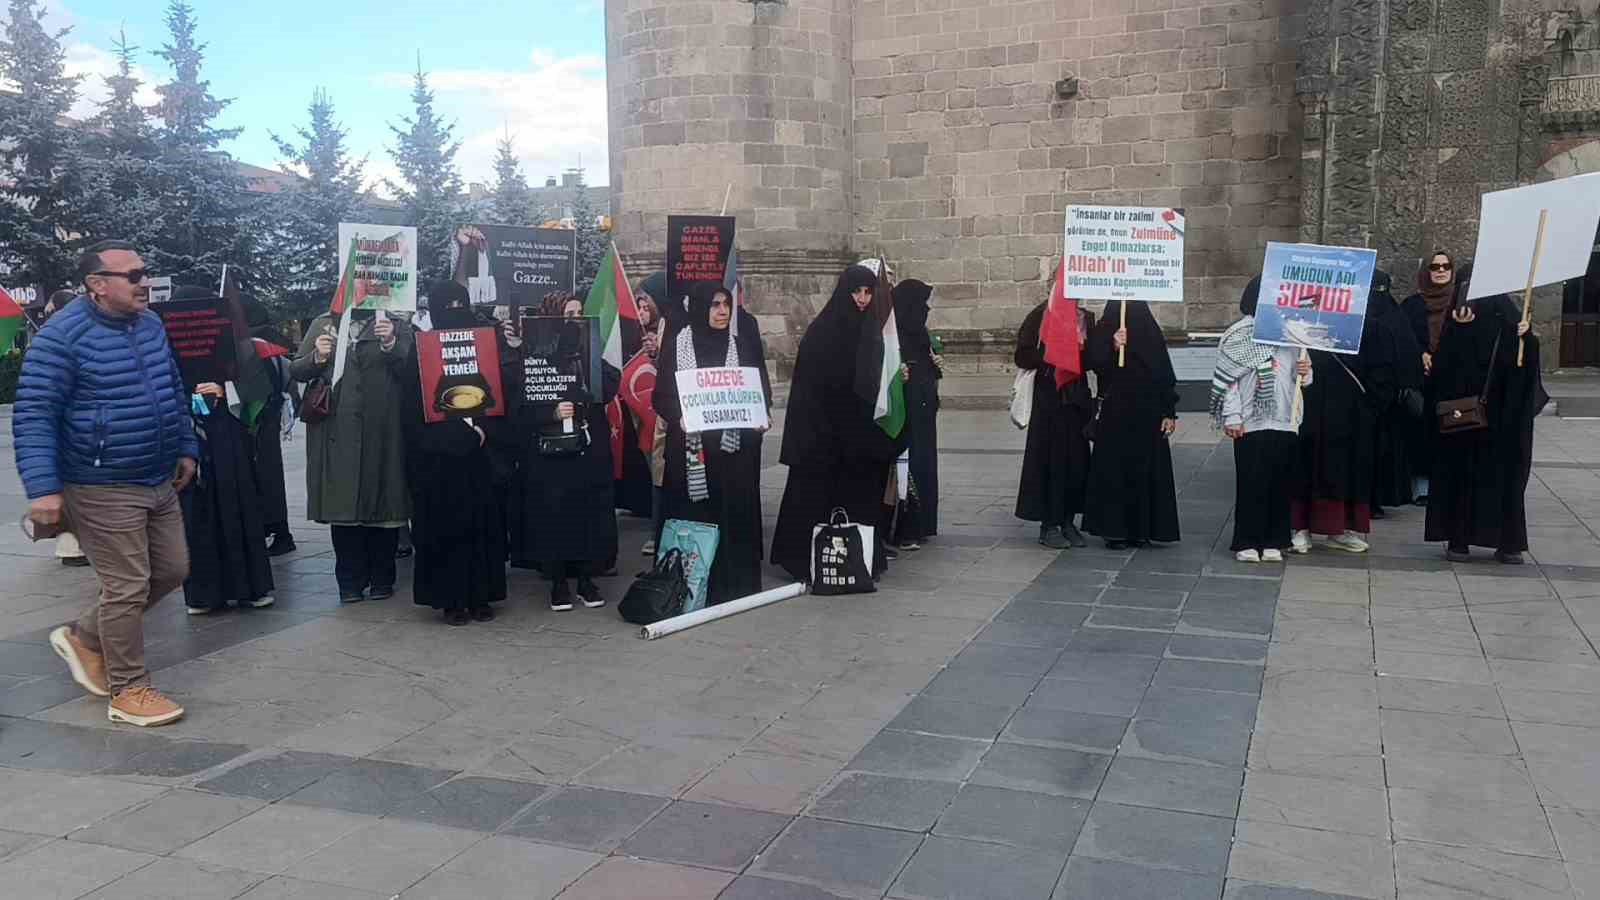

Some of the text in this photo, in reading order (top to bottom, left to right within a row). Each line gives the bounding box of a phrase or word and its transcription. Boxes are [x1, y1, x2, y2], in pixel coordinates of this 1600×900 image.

[1114, 210, 1125, 221] bir
[1128, 210, 1154, 222] zalimi
[1131, 227, 1176, 240] Zulmüne
[1082, 241, 1107, 252] Engel
[1068, 255, 1125, 273] Allah'ın
[1282, 264, 1356, 285] UMUDUN ADI
[441, 346, 476, 361] AKŞAM
[524, 357, 548, 366] DÜNYA
[442, 362, 478, 376] YEMEĞİ
[525, 376, 546, 384] AÇLIK
[696, 370, 744, 388] GAZZE'DE
[525, 383, 568, 393] ÇOCUKLUĞU
[682, 388, 762, 408] ÇOCUKLAR ÖLÜRKEN
